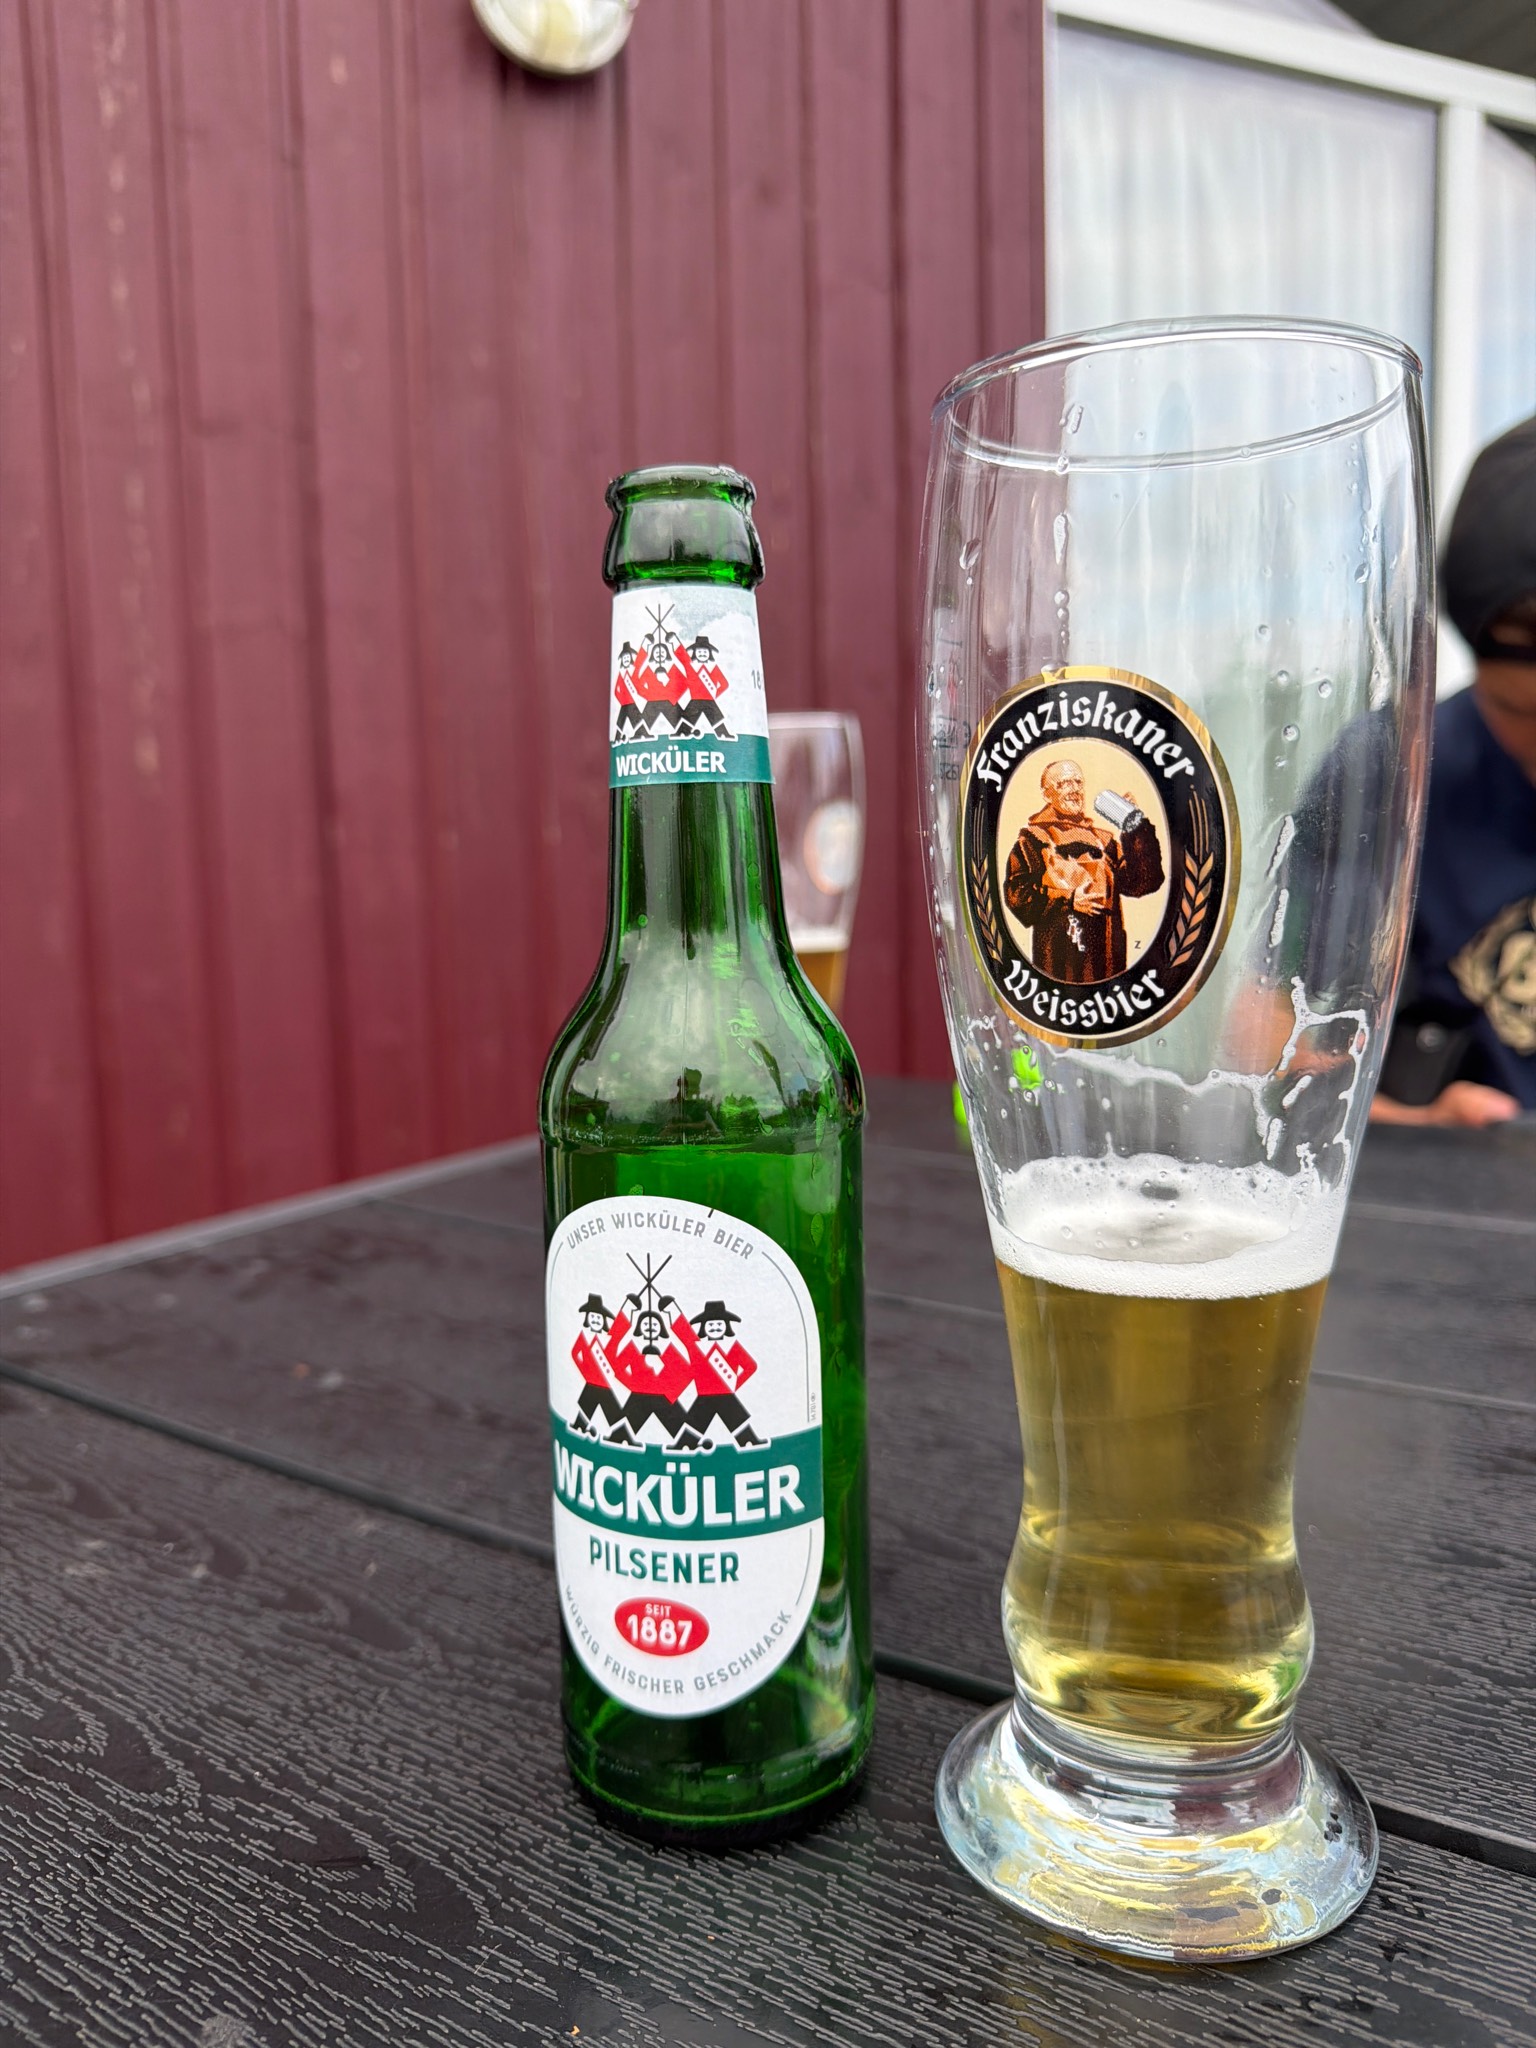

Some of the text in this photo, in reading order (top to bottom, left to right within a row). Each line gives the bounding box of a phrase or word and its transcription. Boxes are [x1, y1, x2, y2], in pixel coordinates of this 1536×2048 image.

[616, 745, 726, 777] WICKÜLER
[976, 690, 1195, 793] Franziskaner
[1003, 960, 1167, 1027] Weissbier
[566, 1210, 754, 1260] UNSER WICKÜLER BIER
[554, 1439, 805, 1527] WICKÜLER
[590, 1535, 740, 1584] PILSENER
[627, 1614, 693, 1649] 1887
[645, 1602, 672, 1617] SEIT
[566, 1584, 792, 1695] WÜRZIG FRISCHER GESCHMACK
